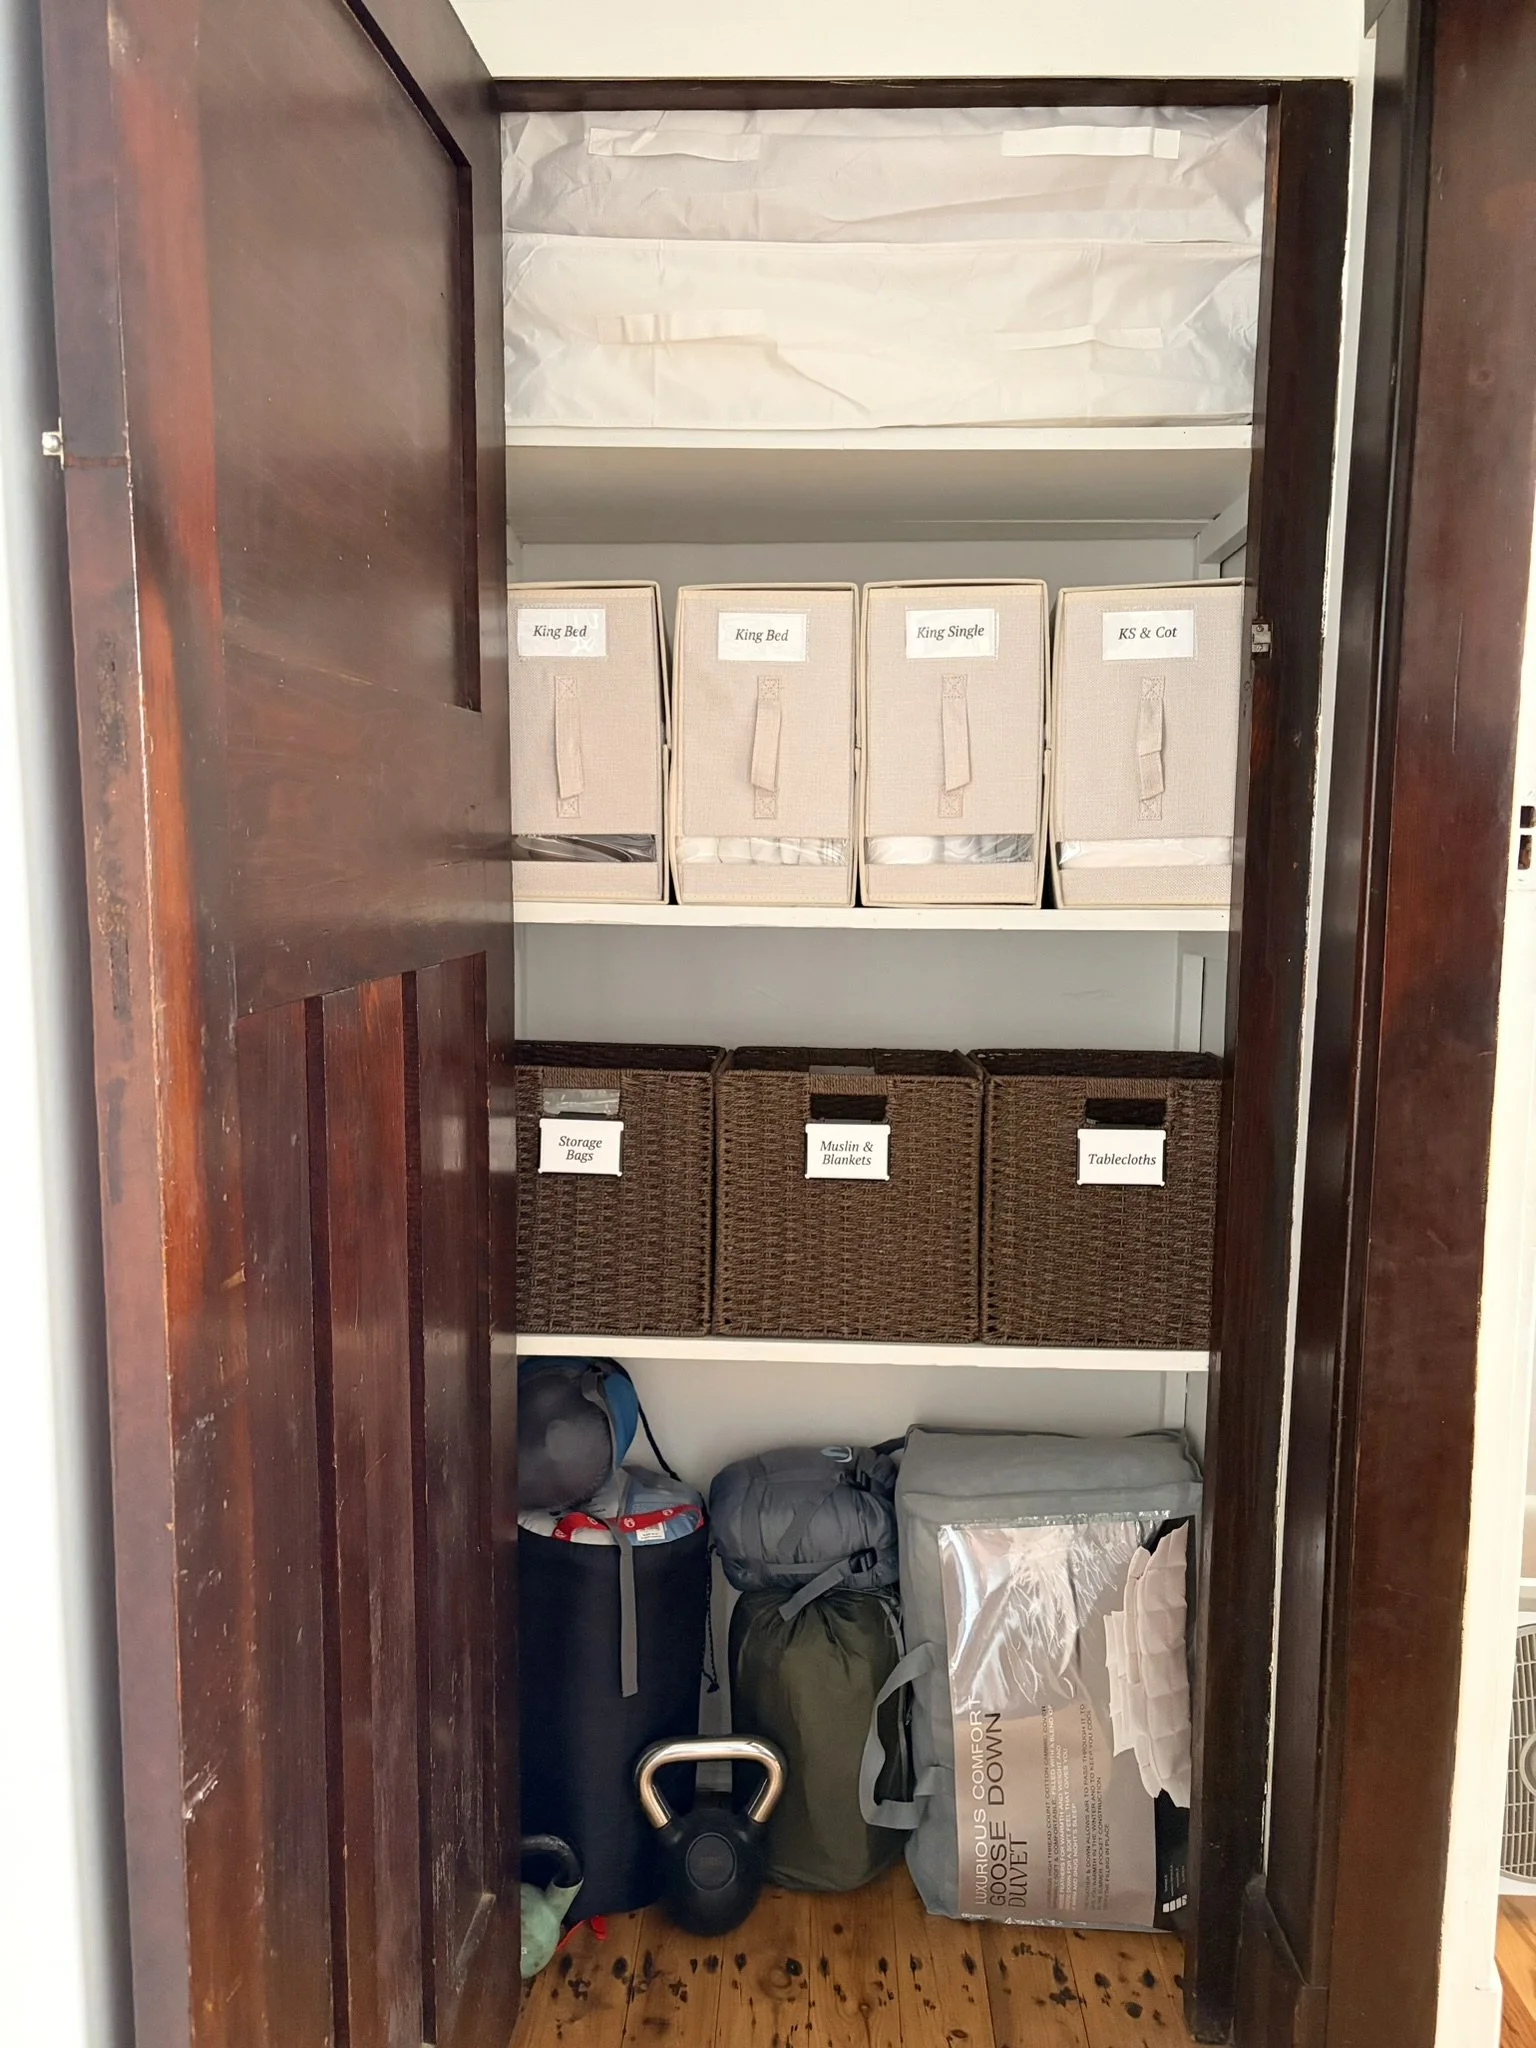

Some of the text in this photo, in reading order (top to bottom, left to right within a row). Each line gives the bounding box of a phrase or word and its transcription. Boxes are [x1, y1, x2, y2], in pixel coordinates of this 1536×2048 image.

[533, 625, 587, 638] King Bed
[734, 628, 789, 642] King Bed
[916, 624, 985, 640] King Single
[1118, 626, 1178, 640] KS & Cot
[558, 1135, 603, 1151] Storage
[819, 1140, 874, 1153] Muslin &
[565, 1149, 594, 1164] Bags
[822, 1154, 872, 1166] Blankets
[1088, 1153, 1157, 1166] Tablecloths
[968, 1695, 988, 1905] LUXURIOUS COMFORT
[984, 1712, 1007, 1906] GOOSE DOWN
[1008, 1832, 1028, 1908] DUVET
